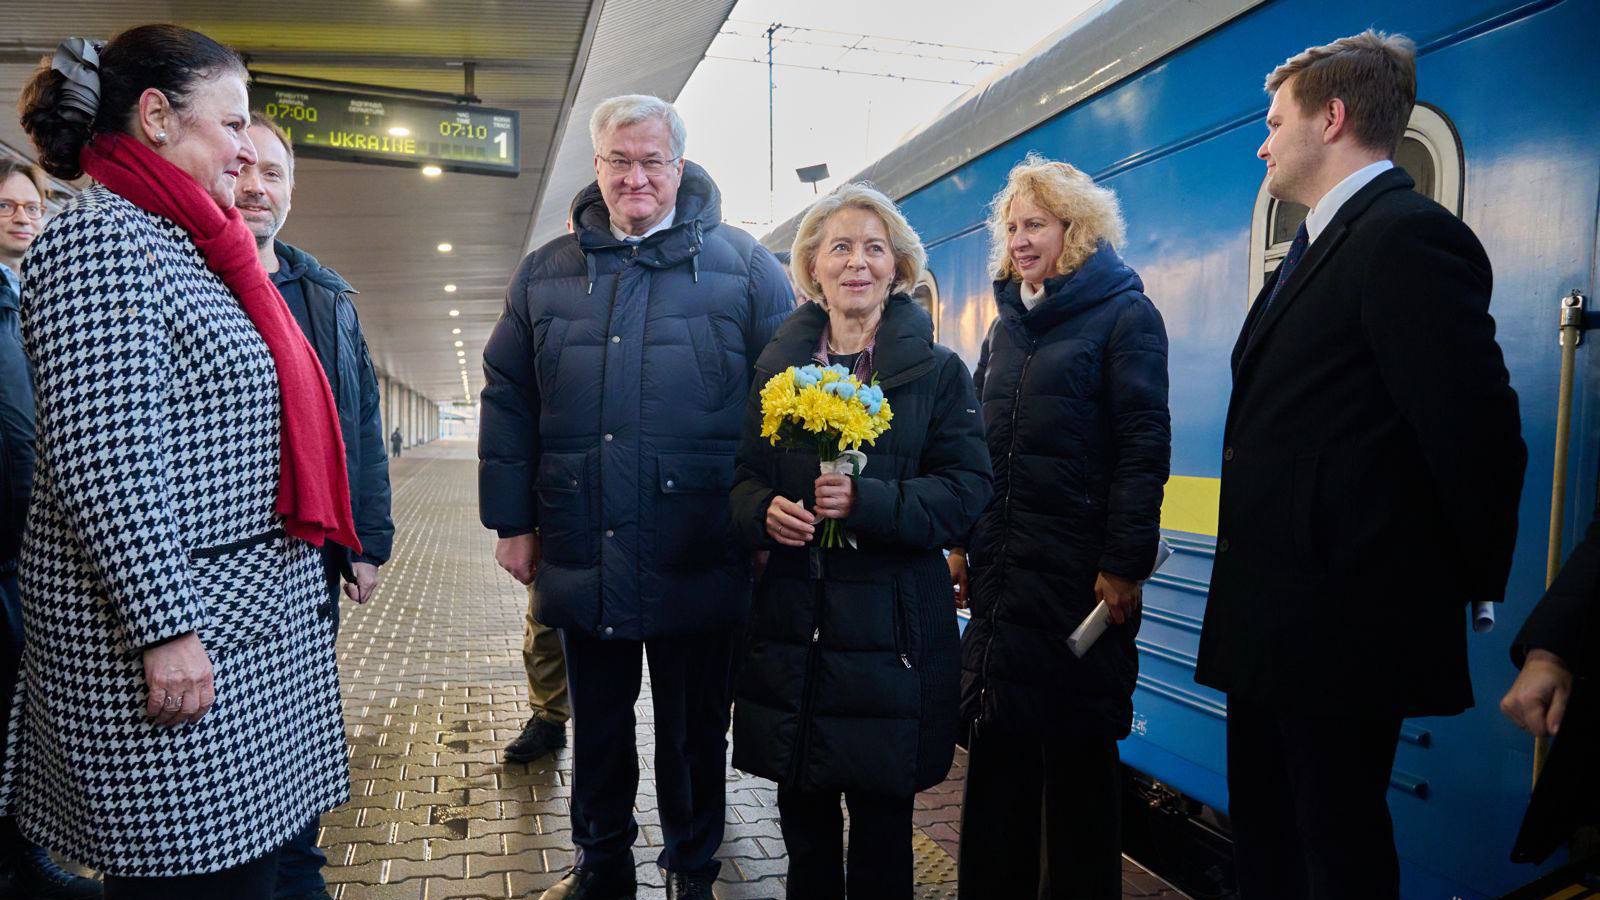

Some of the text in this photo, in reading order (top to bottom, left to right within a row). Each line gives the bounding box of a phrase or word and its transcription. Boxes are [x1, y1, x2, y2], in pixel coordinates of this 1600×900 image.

[266, 102, 318, 122] 07:00
[439, 121, 488, 140] 07:10
[329, 130, 416, 154] UKRAINE
[493, 131, 508, 159] 1
